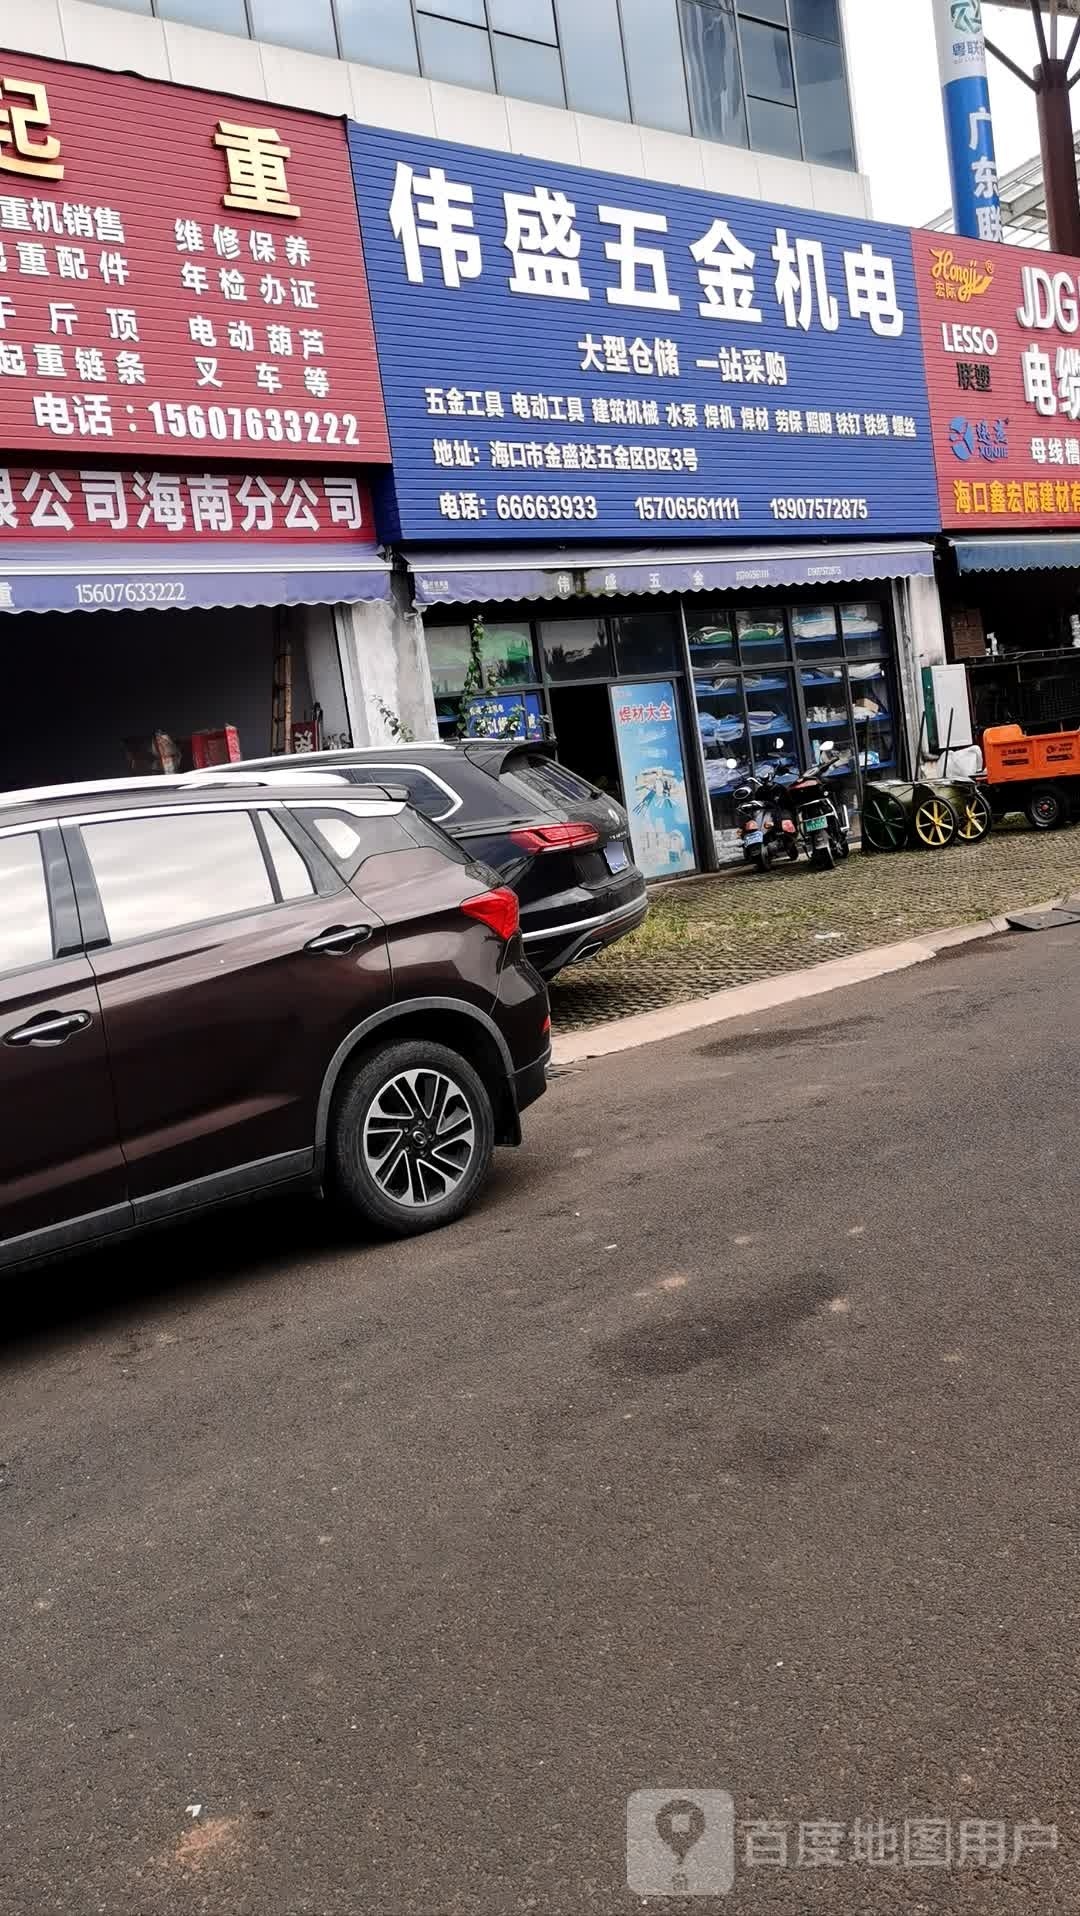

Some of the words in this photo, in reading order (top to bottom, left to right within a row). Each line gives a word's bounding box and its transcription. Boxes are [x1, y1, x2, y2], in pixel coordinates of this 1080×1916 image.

[0, 196, 125, 244] 重机销售
[174, 218, 311, 267] 维修保养
[0, 241, 130, 286] 重配件
[388, 161, 904, 338] 伟盛五金机电
[181, 261, 320, 310] 年检办证
[935, 280, 957, 299] 宏际
[1016, 266, 1080, 334] JDG
[188, 314, 325, 361] 电动葫芦
[578, 333, 681, 378] 大型仓储
[696, 346, 788, 386] 一站采购
[941, 322, 999, 356] LESSO
[0, 340, 146, 385] 起重链条
[194, 356, 330, 399] 叉车等
[956, 361, 992, 393] 联塑
[425, 387, 505, 418] 五金工具
[511, 391, 585, 423] 电动工具
[592, 397, 660, 426] 建筑机械
[666, 402, 699, 429] 水泵
[703, 404, 736, 430] 焊机
[740, 406, 770, 432] 焊材
[775, 409, 803, 434] 劳保
[806, 411, 833, 435] 照明
[892, 414, 917, 438] 螺丝
[635, 496, 740, 521] 15706561111
[770, 496, 869, 520] 13907572875
[75, 582, 186, 604] 15607633222
[617, 700, 672, 725] 焊材大全
